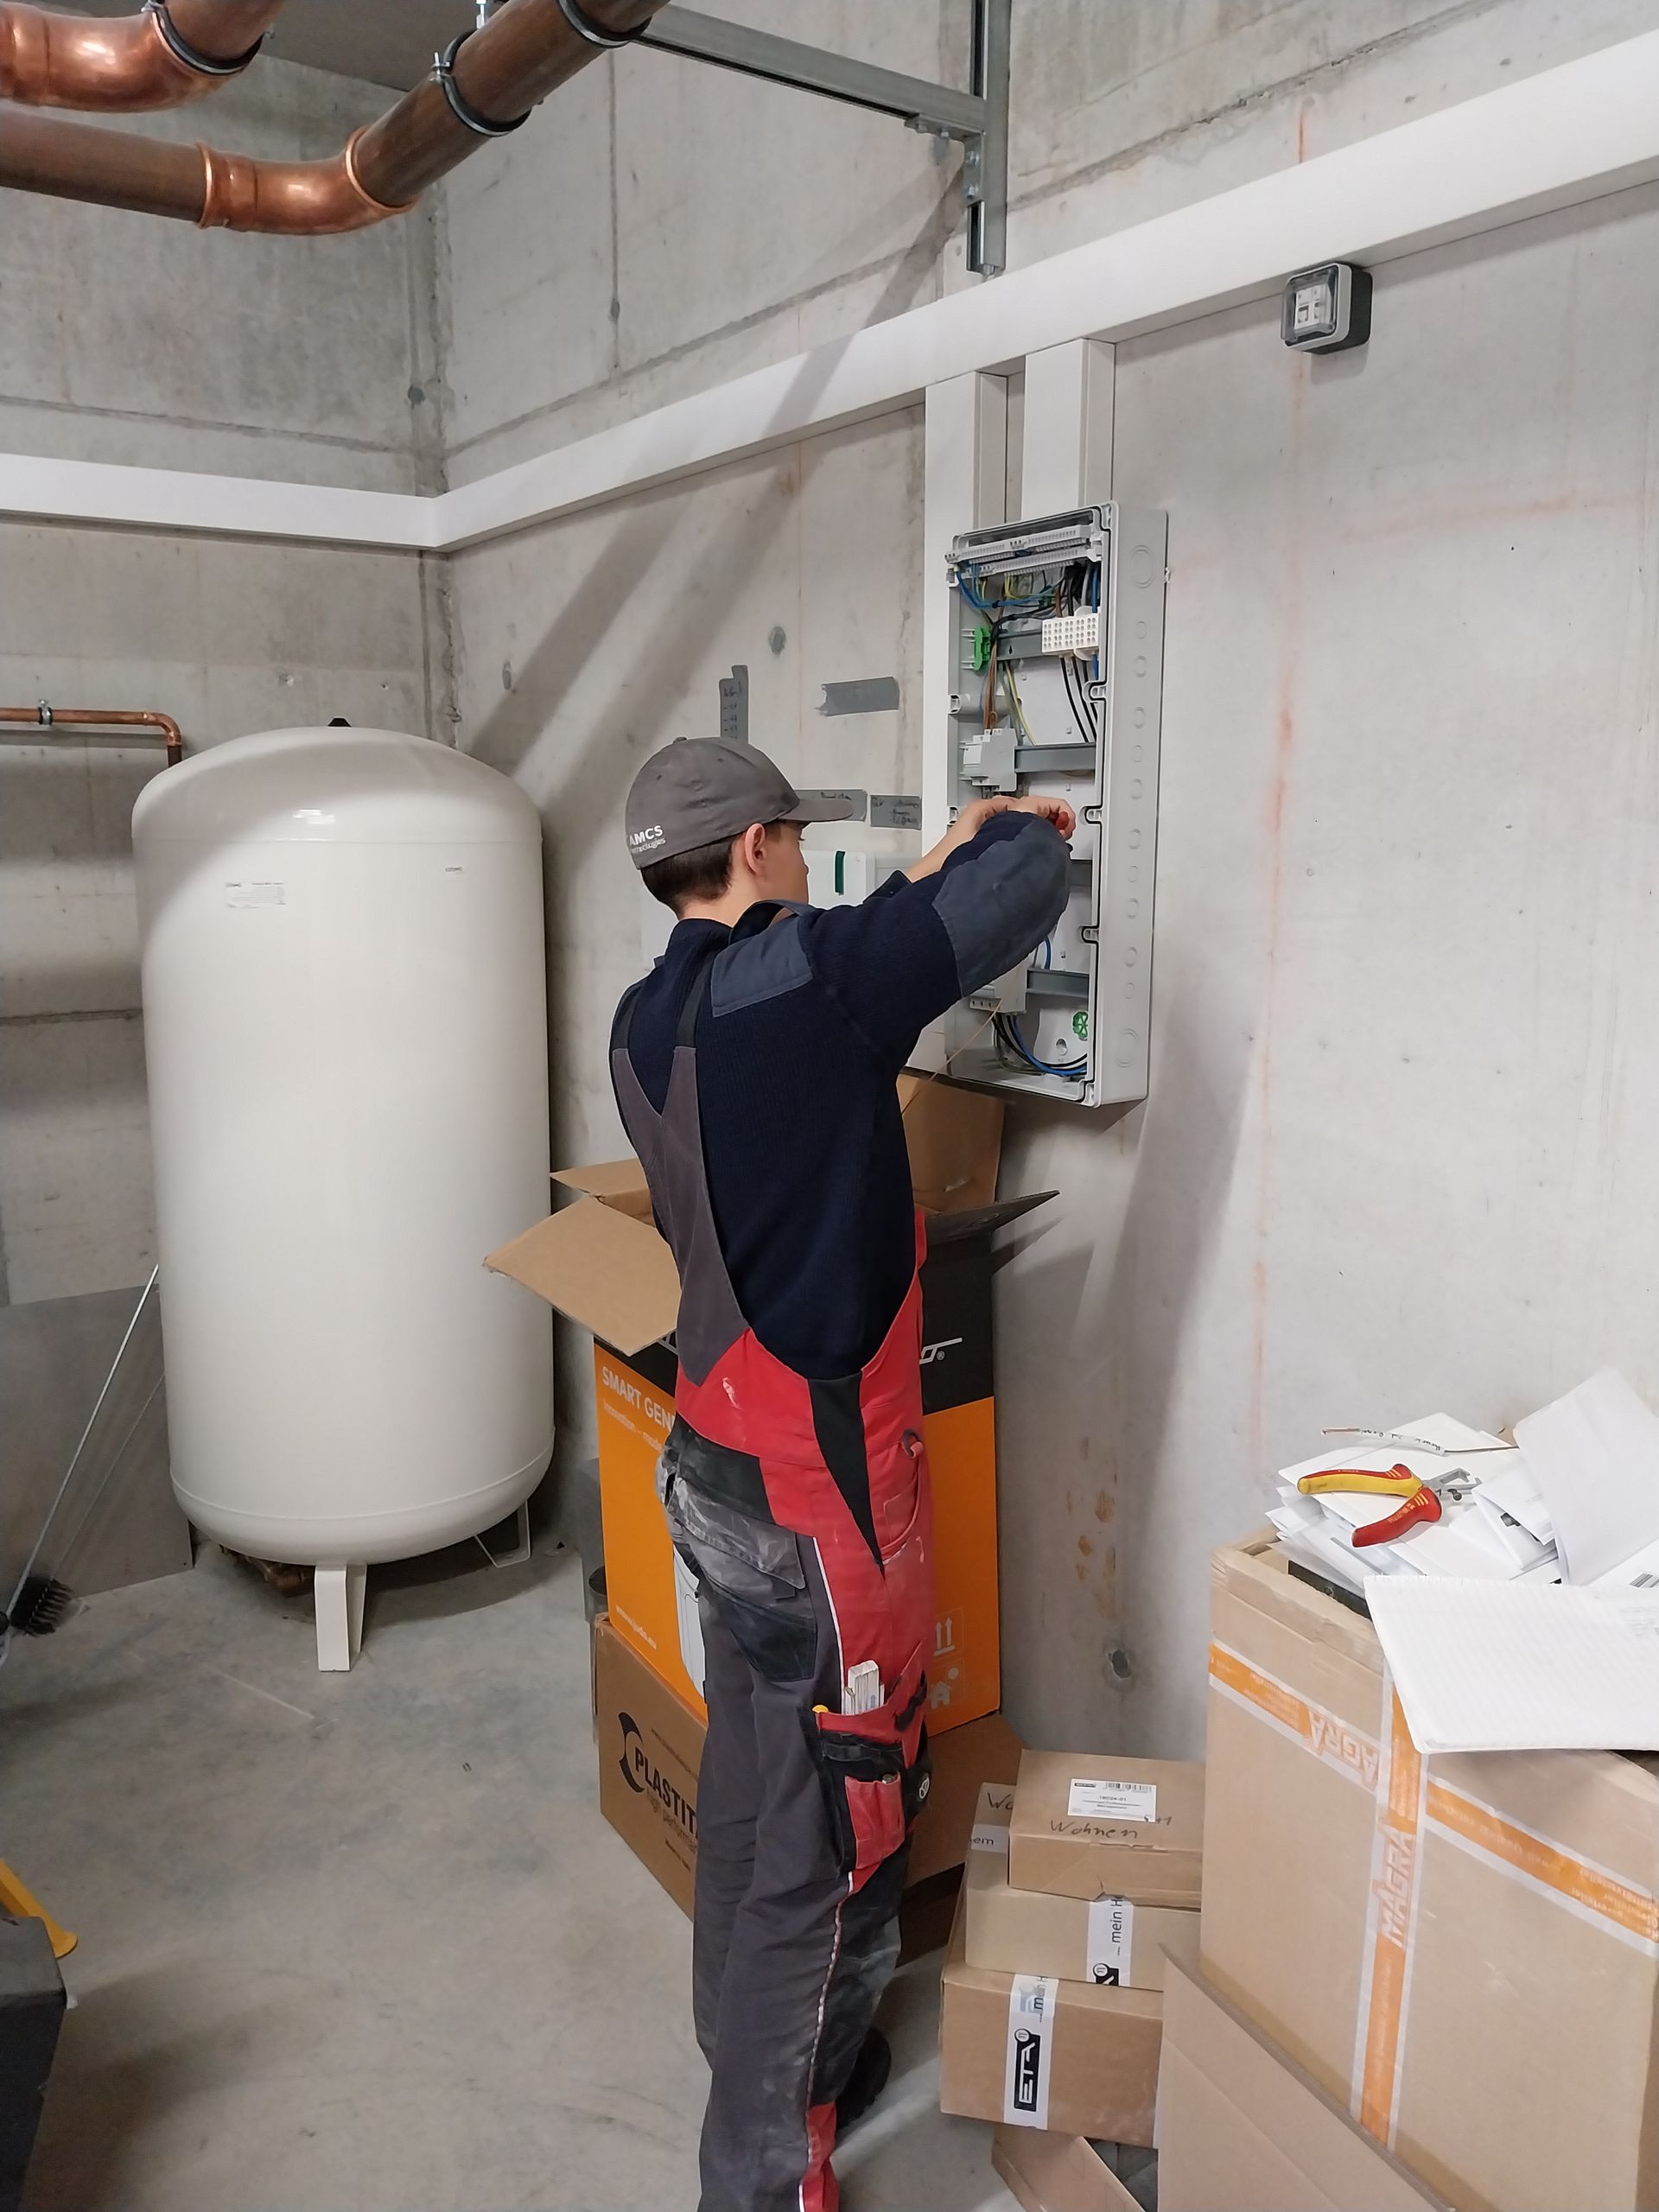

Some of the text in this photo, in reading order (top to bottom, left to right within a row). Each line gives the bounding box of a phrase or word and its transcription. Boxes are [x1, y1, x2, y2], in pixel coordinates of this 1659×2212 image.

[601, 1365, 642, 1409] SMART
[635, 1746, 698, 1840] PLASTIT
[1051, 1819, 1139, 1840] Wohnen
[1372, 1818, 1415, 1950] MAGRA
[1110, 1910, 1123, 1943] mein
[1018, 2041, 1036, 2105] ETA
